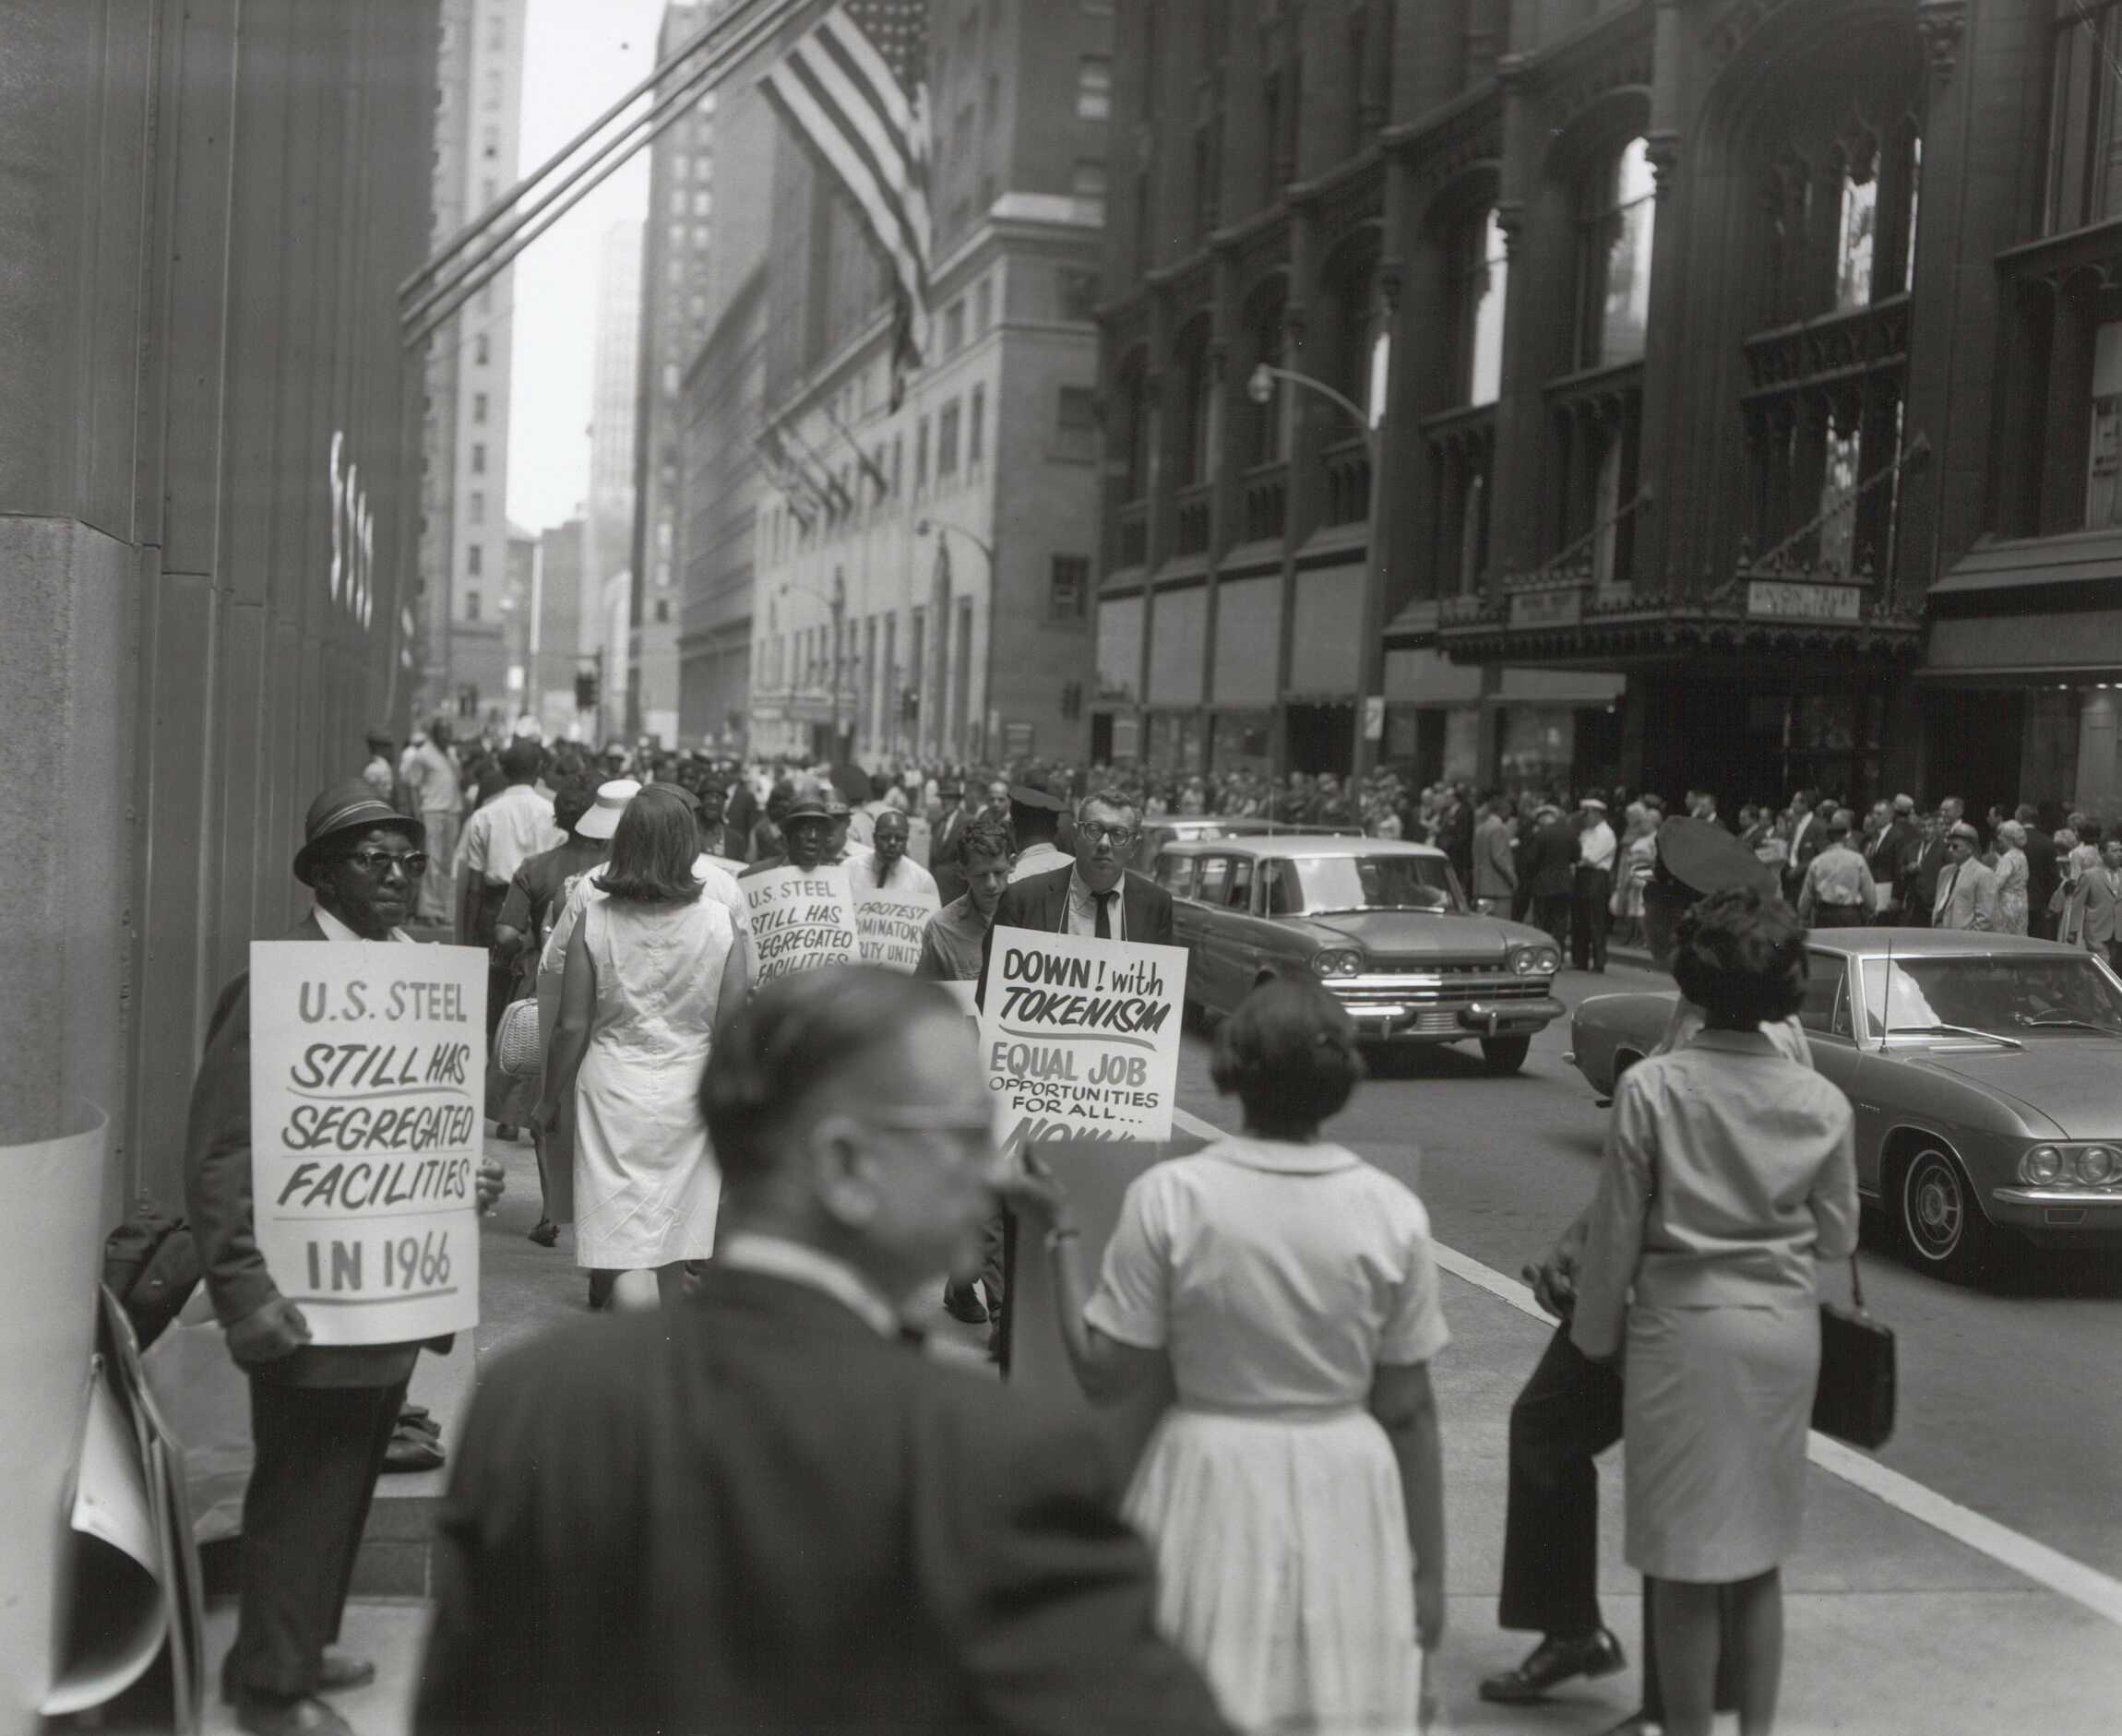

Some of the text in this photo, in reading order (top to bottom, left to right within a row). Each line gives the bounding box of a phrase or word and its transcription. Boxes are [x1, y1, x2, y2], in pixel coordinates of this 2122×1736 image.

[748, 880, 836, 910] U.S. STEEL
[857, 902, 929, 920] PROTEST
[751, 905, 842, 936] STILL HAS
[1112, 960, 1163, 997] with
[298, 981, 468, 1024] U.S. STEEL
[1000, 986, 1172, 1034] TOKENISM
[291, 1043, 470, 1088] STILL HAS
[989, 1041, 1148, 1088] EQUAL JOB
[989, 1076, 1160, 1109] OPPORTUNITIES
[1012, 1096, 1062, 1114] FOR
[281, 1105, 474, 1152] SEGREGATED
[278, 1158, 471, 1210] FACILITIES
[306, 1231, 451, 1291] IN 1966
